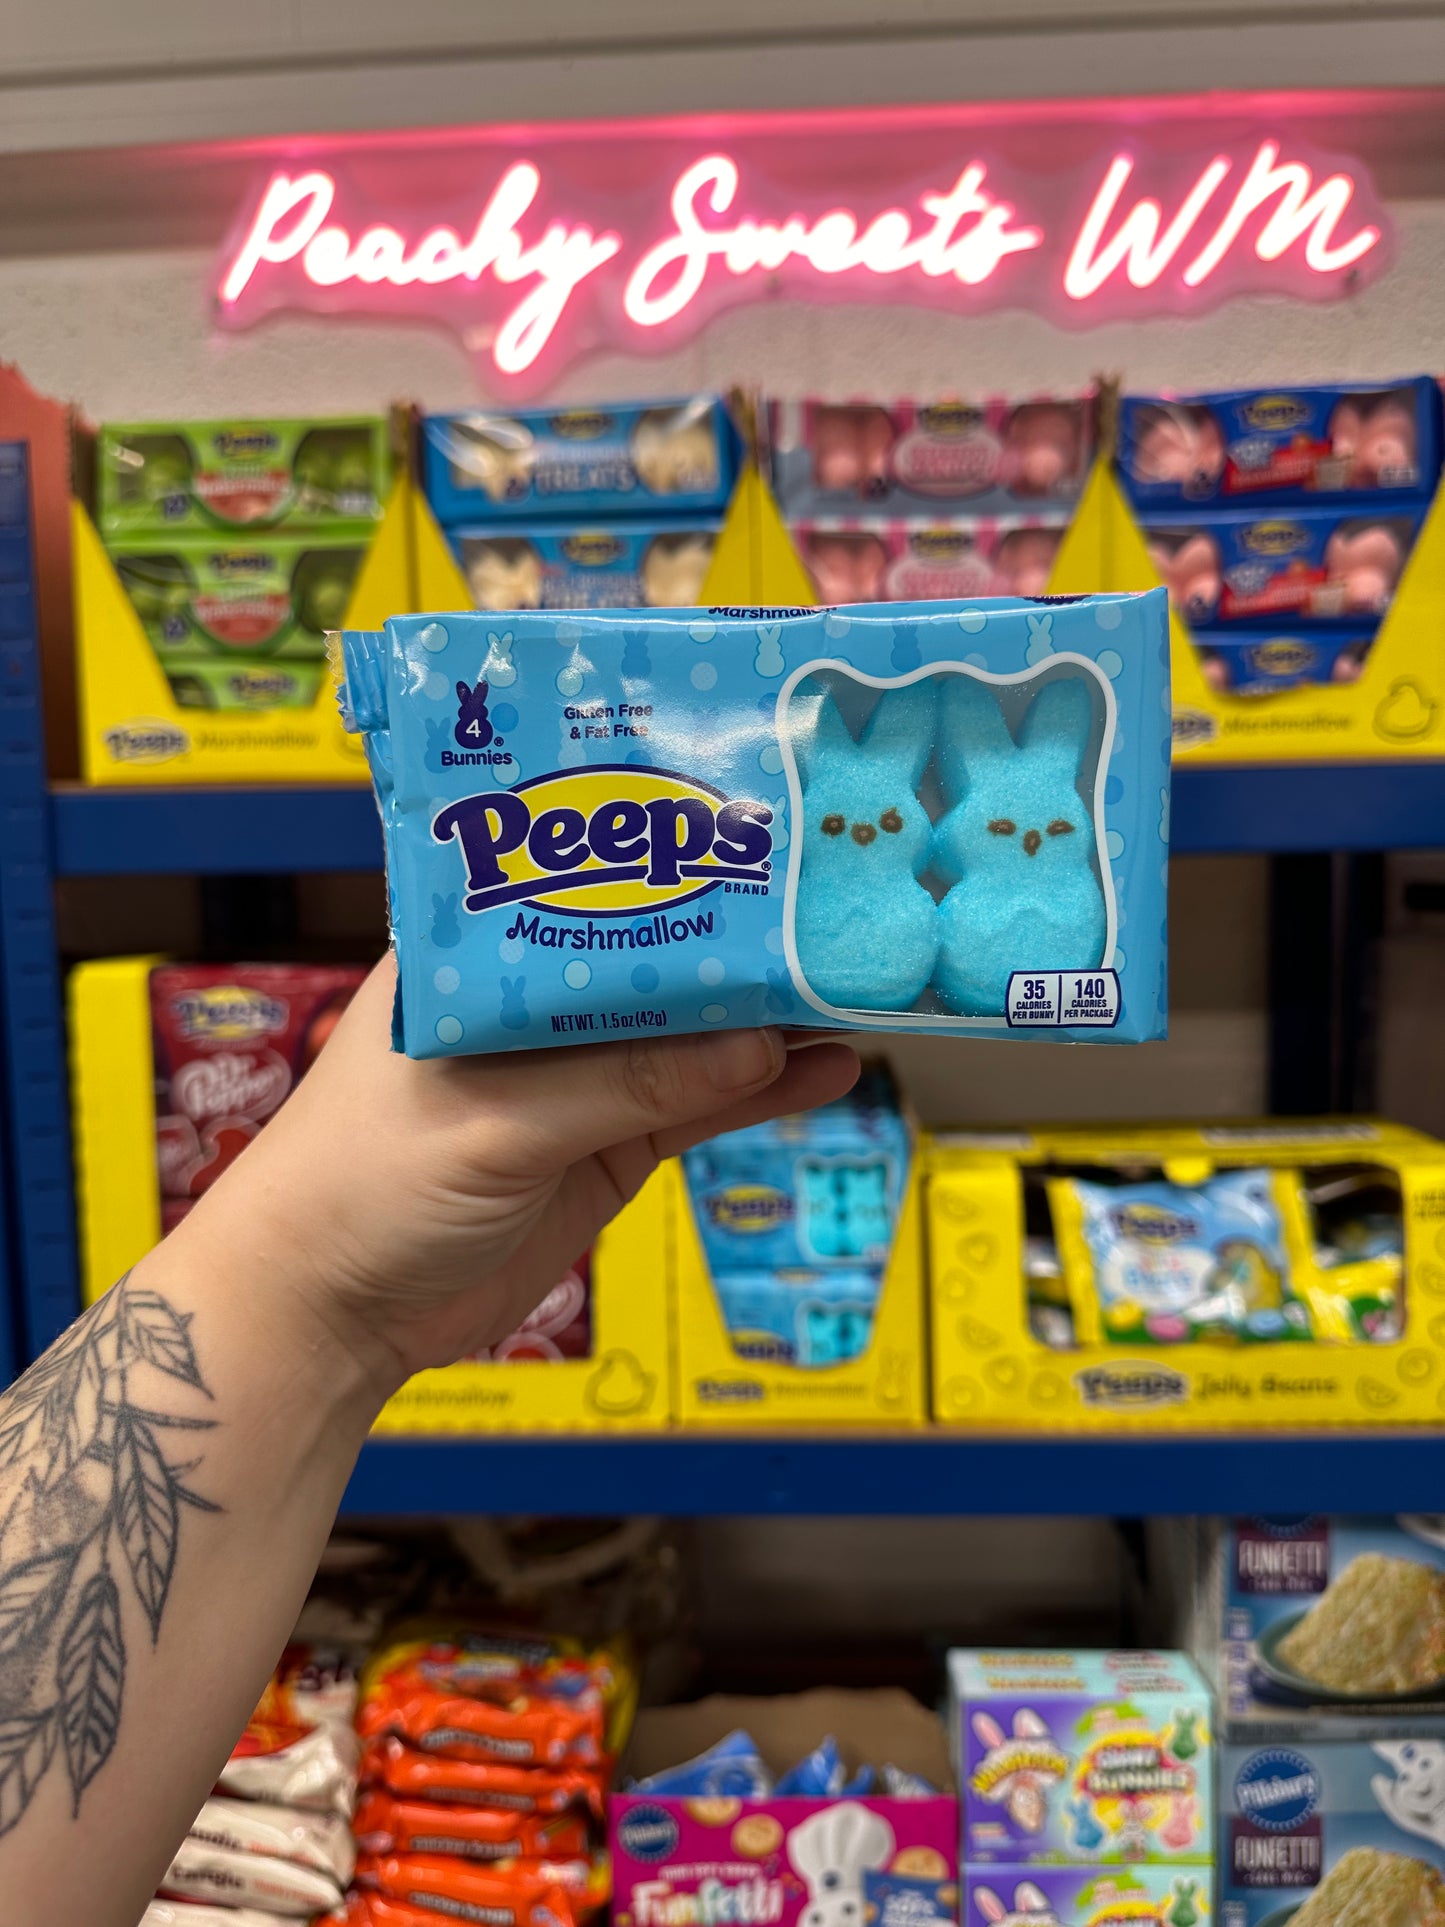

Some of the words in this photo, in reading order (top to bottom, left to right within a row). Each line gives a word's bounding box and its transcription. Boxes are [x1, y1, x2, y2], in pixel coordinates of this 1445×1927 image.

[220, 160, 622, 374] Peachy
[624, 154, 1042, 326] Sweets
[563, 704, 614, 720] Gluten
[618, 704, 653, 718] Free
[465, 718, 482, 738] 4
[569, 726, 581, 739] &
[584, 725, 610, 739] Fat
[613, 723, 648, 738] Free
[441, 749, 512, 767] Bunnies
[431, 792, 775, 893] Peeps
[724, 882, 769, 896] BRAND
[505, 911, 714, 950] Marshmallow
[1023, 979, 1046, 1000] 35
[1074, 978, 1105, 999] 140
[1016, 1000, 1052, 1010] CALORIES
[1071, 999, 1107, 1008] CALORIES
[1012, 1010, 1028, 1019] PER
[1028, 1010, 1055, 1019] BUNNY
[1064, 1009, 1079, 1018] PER
[1079, 1008, 1114, 1018] PACKAGE
